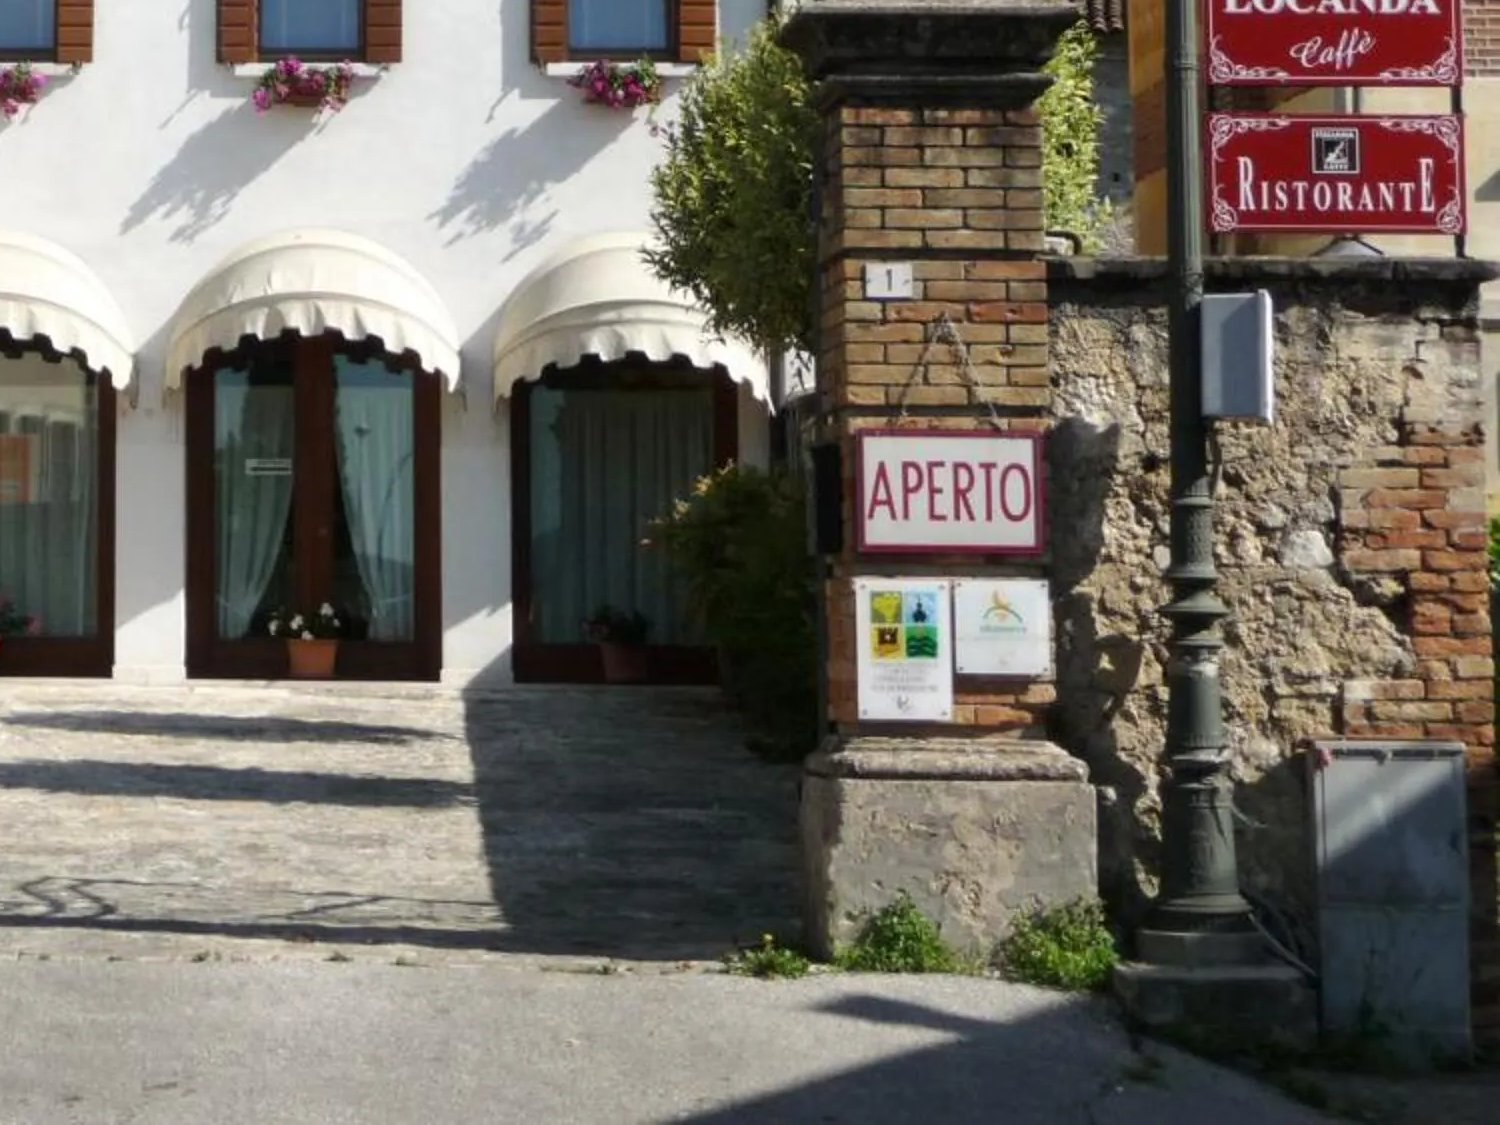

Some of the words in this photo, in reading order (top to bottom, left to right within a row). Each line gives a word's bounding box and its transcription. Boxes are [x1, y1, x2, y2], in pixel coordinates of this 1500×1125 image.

[1290, 28, 1376, 69] Caffè
[886, 268, 893, 292] 1
[867, 460, 1033, 523] APERTO
